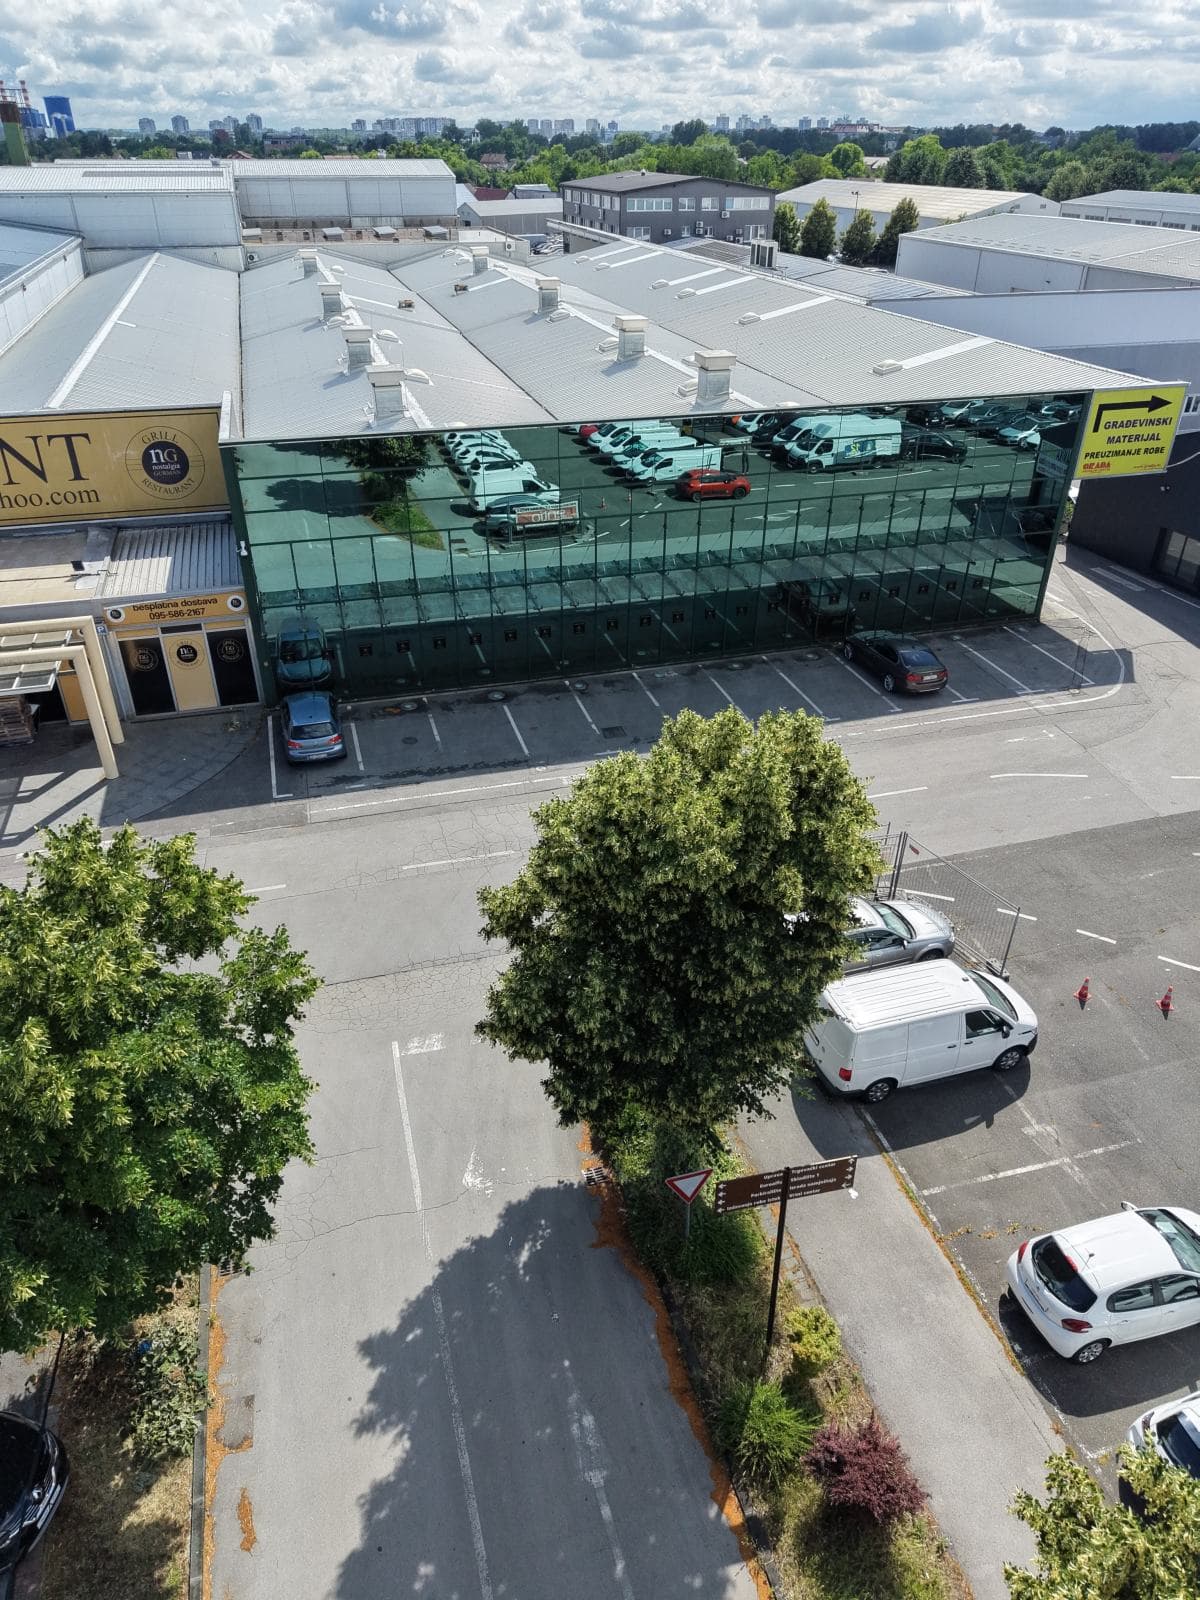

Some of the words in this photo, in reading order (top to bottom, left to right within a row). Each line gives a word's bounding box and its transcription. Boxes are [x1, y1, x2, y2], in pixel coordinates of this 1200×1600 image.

[1103, 417, 1173, 430] GRAĐEVINSKI
[141, 431, 178, 444] GRILL
[1106, 432, 1161, 445] MATERIJAL
[0, 433, 91, 486] NT
[1084, 448, 1141, 460] PREUZIMANJE
[1143, 446, 1166, 455] ROBE
[141, 478, 195, 495] RESTAURANT
[0, 490, 101, 509] hoo.com
[132, 600, 179, 612] besplatna
[180, 597, 218, 607] dostava
[149, 608, 206, 620] 095-586-2167
